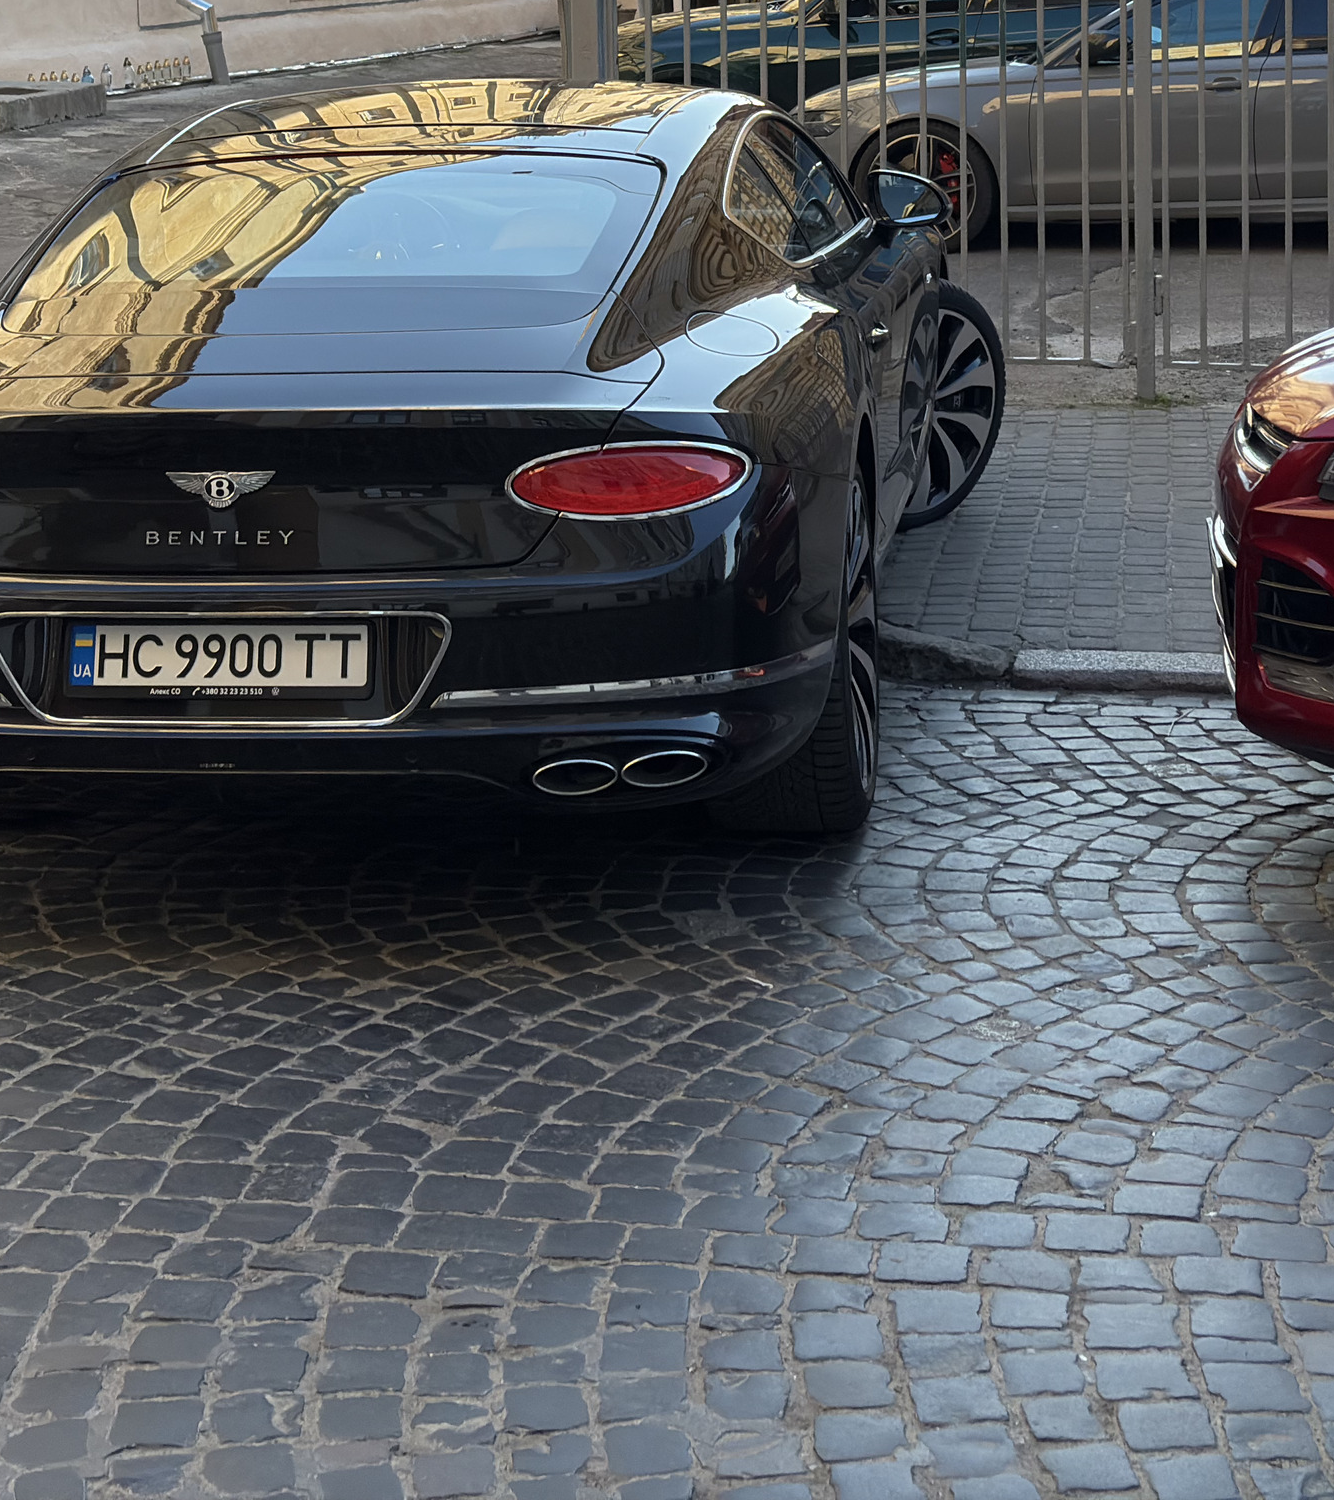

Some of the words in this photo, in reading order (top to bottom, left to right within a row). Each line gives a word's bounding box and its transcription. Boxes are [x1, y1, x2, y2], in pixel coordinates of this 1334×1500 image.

[145, 530, 294, 545] BENTLEY
[97, 633, 164, 679] HC
[175, 633, 283, 679] 9900
[294, 633, 362, 679] TT
[73, 664, 92, 678] UA
[149, 687, 170, 695] Алекс
